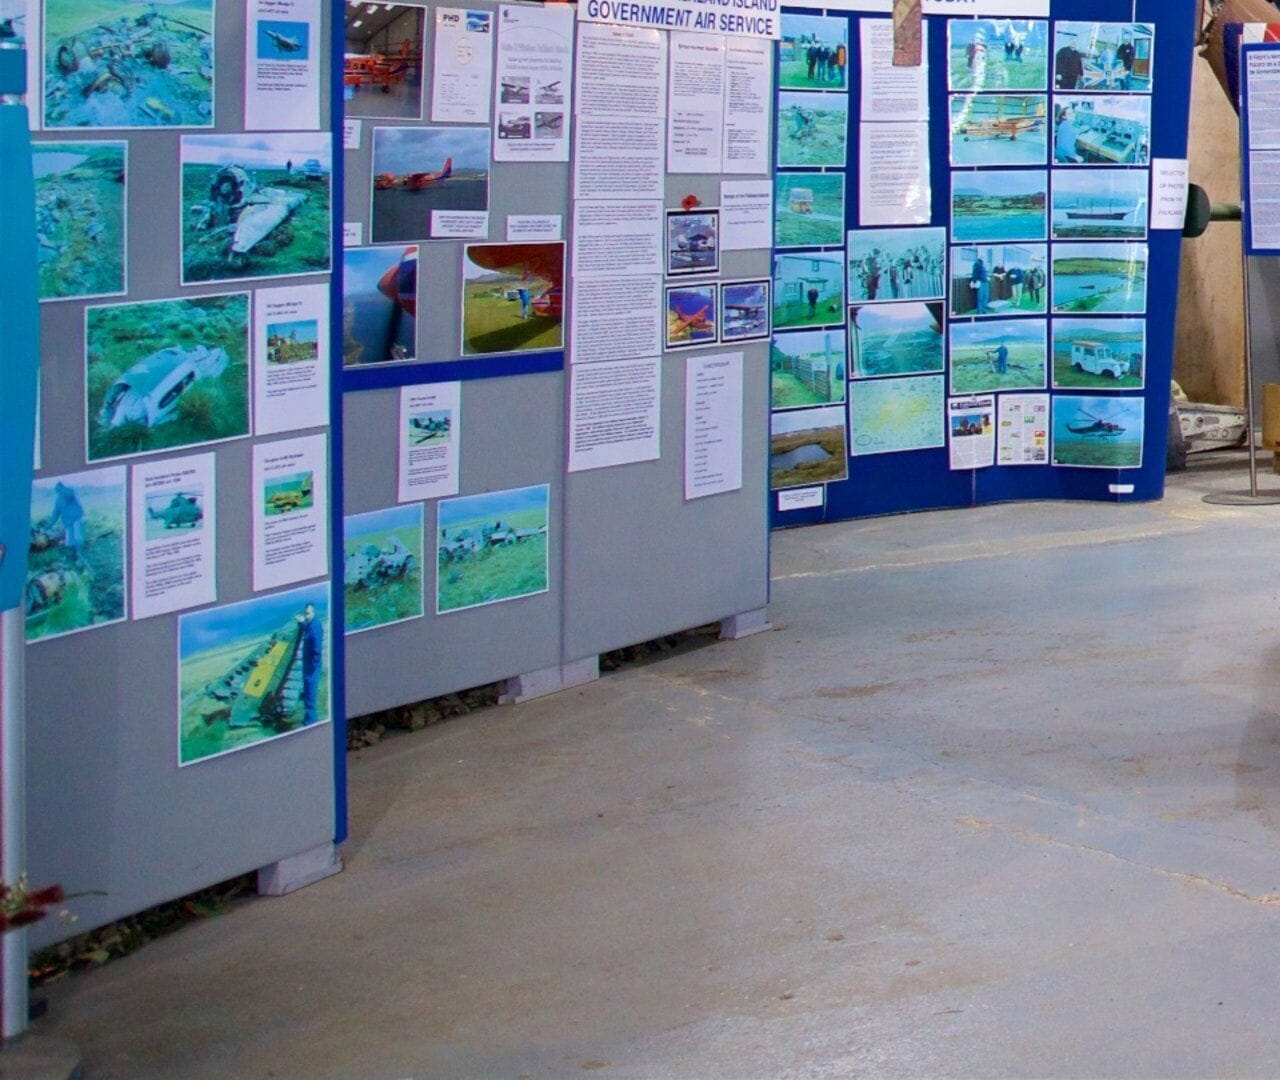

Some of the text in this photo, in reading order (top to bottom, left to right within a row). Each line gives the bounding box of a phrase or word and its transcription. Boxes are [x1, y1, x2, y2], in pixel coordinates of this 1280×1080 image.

[587, 0, 773, 36] GOVERNMENT AIR SERVICE
